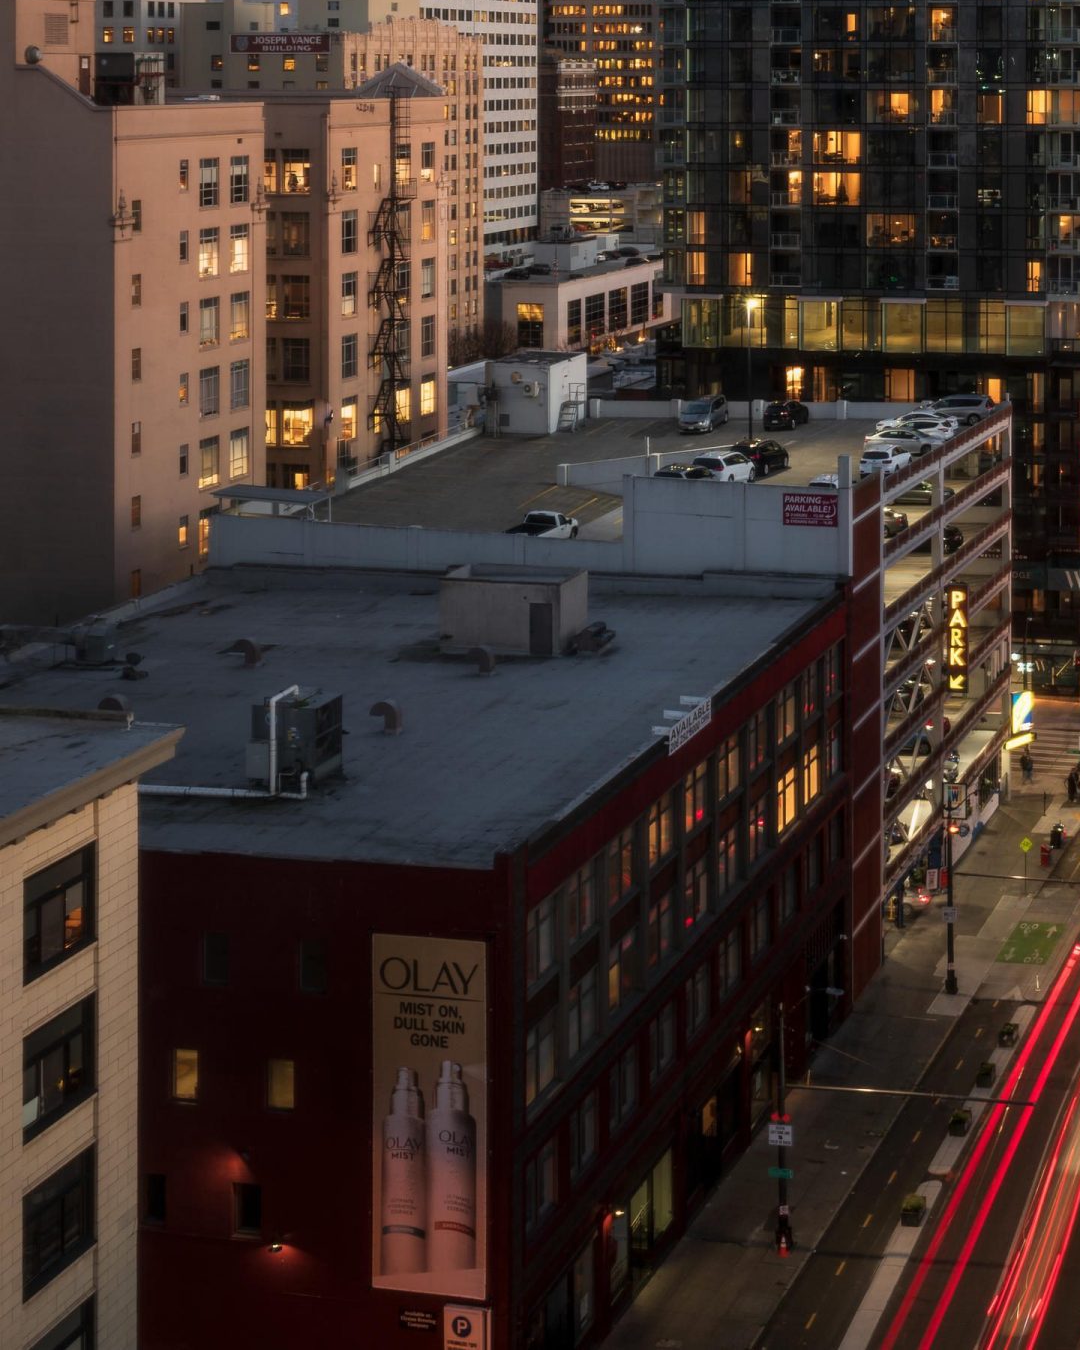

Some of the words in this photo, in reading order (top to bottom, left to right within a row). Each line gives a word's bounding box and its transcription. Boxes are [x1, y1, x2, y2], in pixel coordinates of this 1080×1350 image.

[252, 36, 287, 45] JOSEPH
[291, 36, 322, 45] VANCE
[784, 495, 822, 504] PARKING
[784, 504, 831, 513] AVAILABLE!
[949, 590, 967, 666] PARK
[671, 699, 711, 741] AVAILABLE
[379, 956, 479, 995] OLAY
[400, 1001, 434, 1016] MIST
[394, 1017, 428, 1032] DULL
[432, 1020, 465, 1035] SKIN
[410, 1033, 448, 1049] GONE
[385, 1137, 422, 1152] OLAY
[391, 1152, 415, 1161] MIST
[446, 1146, 471, 1159] MIST
[457, 1319, 468, 1334] P
